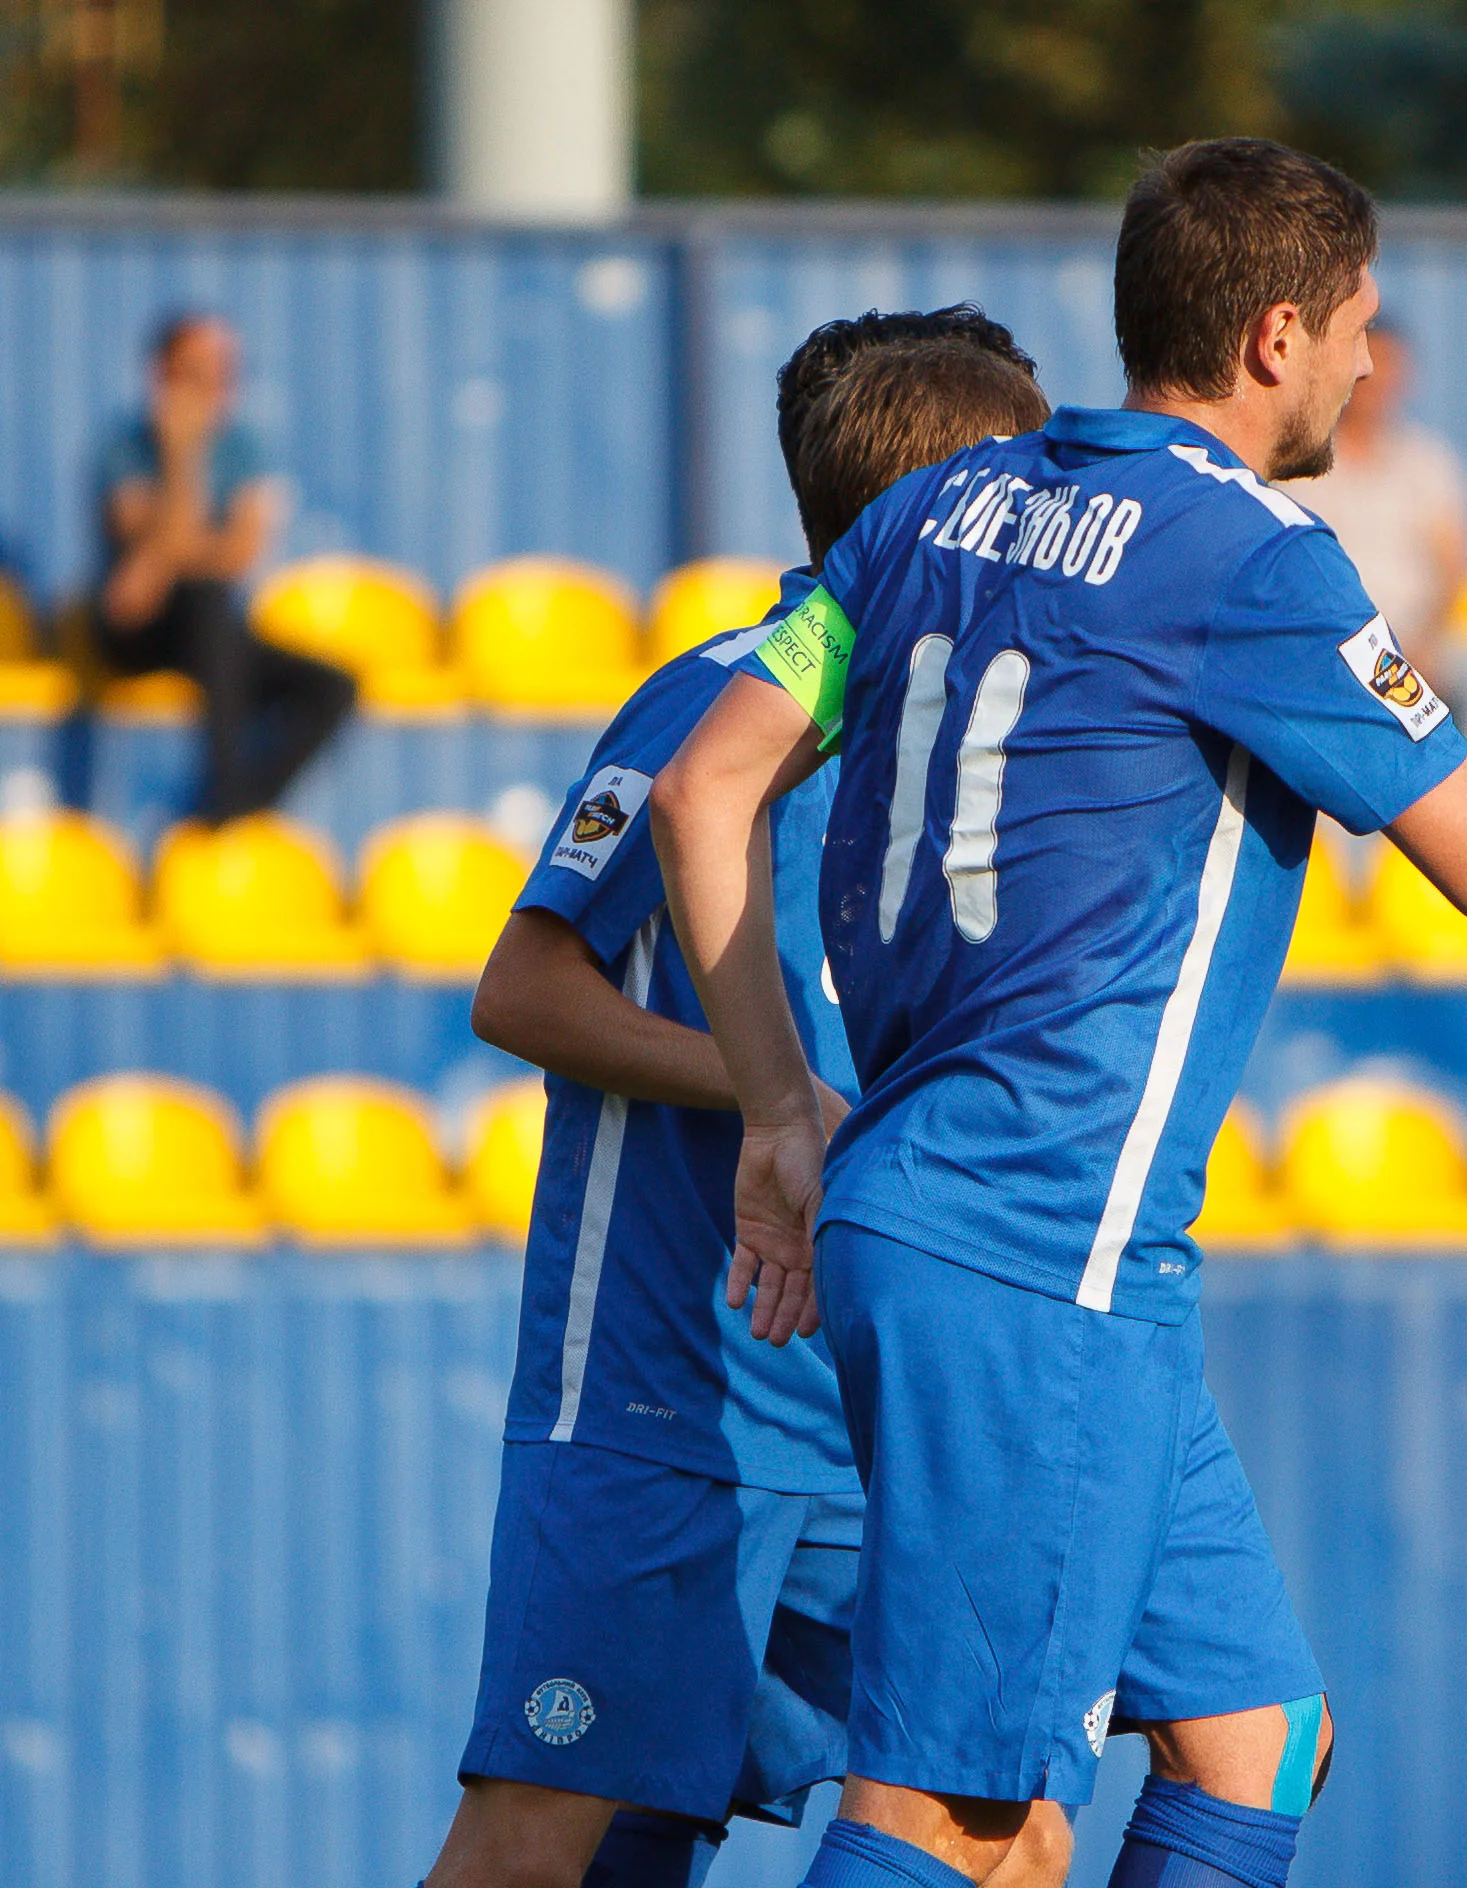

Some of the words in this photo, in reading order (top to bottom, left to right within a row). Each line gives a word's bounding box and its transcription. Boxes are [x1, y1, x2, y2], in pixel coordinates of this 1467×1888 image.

[772, 626, 816, 673] ESPECT
[878, 632, 1031, 944] 11
[626, 1402, 678, 1421] DRI-FIT
